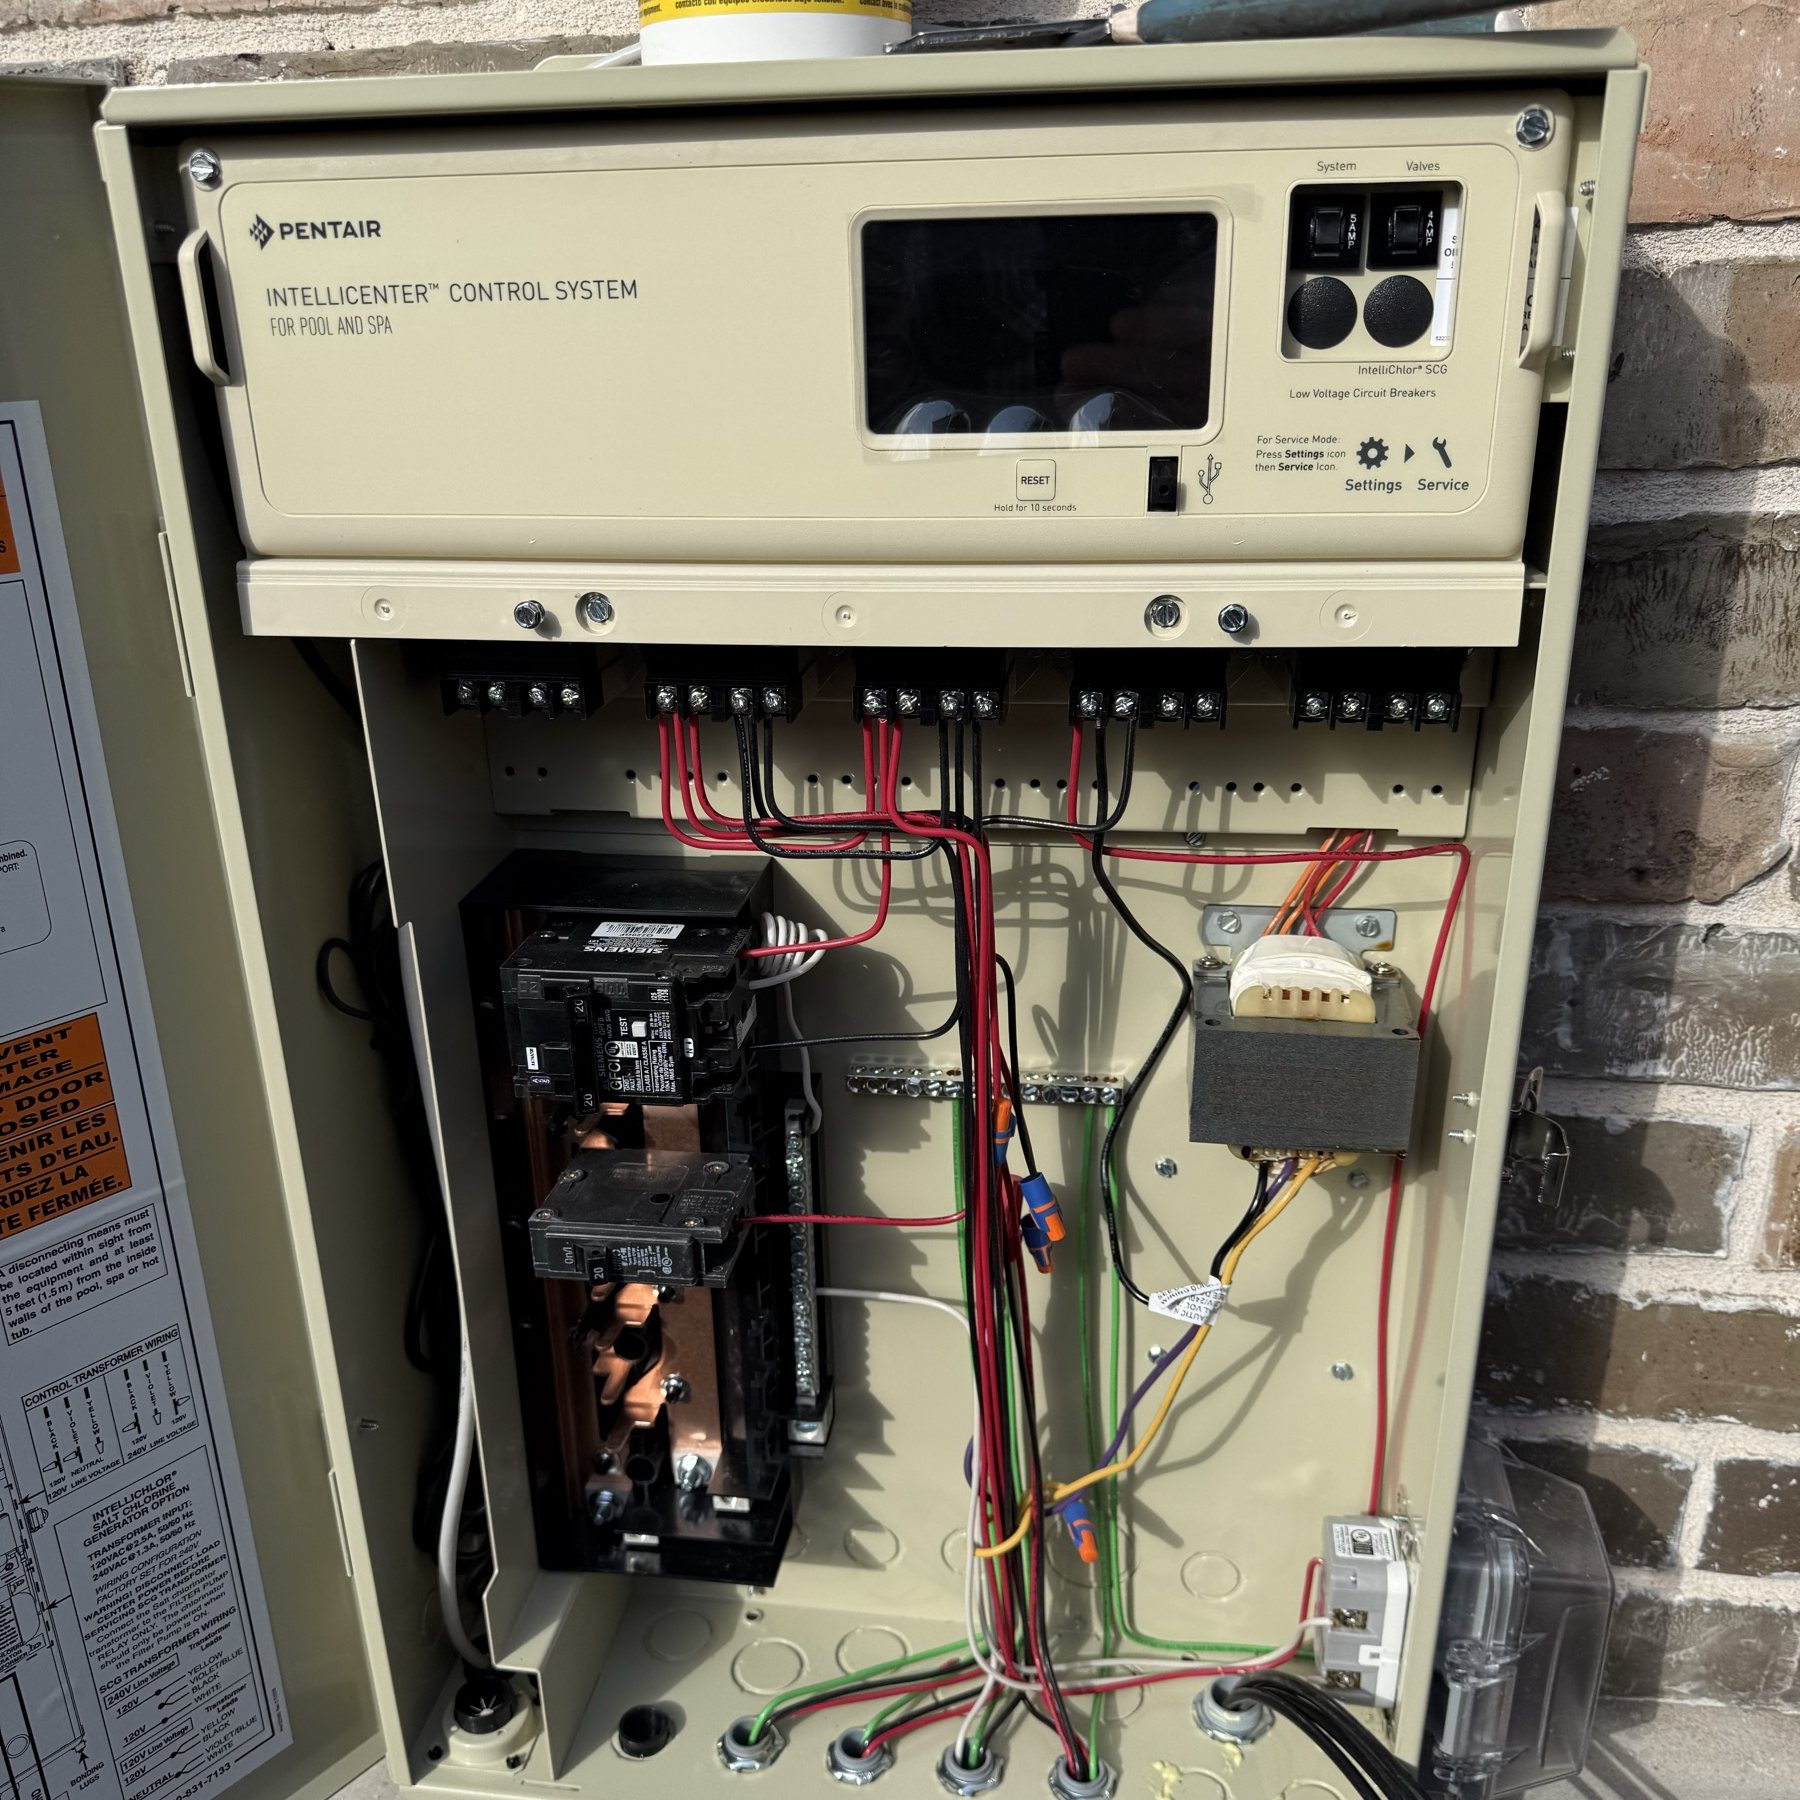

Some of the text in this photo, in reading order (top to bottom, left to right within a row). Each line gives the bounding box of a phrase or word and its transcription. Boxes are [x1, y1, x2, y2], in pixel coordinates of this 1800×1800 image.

[1316, 161, 1356, 173] System
[1406, 161, 1440, 172] Valves
[279, 220, 382, 240] PENTAIR
[1348, 214, 1356, 250] 5 AMP
[1425, 210, 1434, 246] 4 AMP
[449, 281, 550, 303] CONTROL
[555, 279, 638, 301] SYSTEM
[270, 315, 393, 336] FOR POOL AND SPA
[1425, 364, 1448, 375] SCG
[1290, 388, 1436, 400] Low Voltage Circuit Breakers
[1256, 436, 1272, 444] For
[1275, 435, 1309, 444] Service
[1255, 463, 1276, 472] then
[1278, 462, 1314, 471] Service
[1256, 450, 1346, 460] Press Settings icon
[1021, 476, 1050, 485] RESET
[1345, 479, 1470, 493] Settings Service
[994, 504, 1014, 512] Hold
[583, 946, 663, 954] SIEMENS
[575, 999, 584, 1013] 20
[619, 1017, 629, 1036] TEST
[607, 1058, 623, 1090] GFCI
[16, 1072, 105, 1112] DOOR
[584, 1093, 593, 1106] 20
[61, 1112, 106, 1139] LES
[40, 1131, 118, 1169] D'EAU.
[60, 1165, 90, 1186] LA
[28, 1174, 122, 1222] FERMÉE.
[8, 1209, 150, 1274] disconnecting means must
[0, 1222, 152, 1292] be located within sight from
[2, 1233, 154, 1304] the equipment and at least
[5, 1245, 156, 1316] 5 feet from the inside
[593, 1267, 604, 1279] 20
[8, 1256, 160, 1328] walls of the pool, spa or hot
[11, 1327, 32, 1341] tub.
[25, 1328, 178, 1408] CONTROL TRANSFORMER WIRING
[127, 1420, 197, 1460] 240V VOLTAGE
[50, 1458, 105, 1488] 120V NEUTRAL
[71, 1459, 121, 1488] LINE VOLTAGE
[83, 1484, 190, 1547] GENERATOR OPTION
[93, 1482, 176, 1532] SALT CHLORINE
[87, 1500, 192, 1561] TRANSFORMER INPUT:
[158, 1517, 180, 1534] 50/60
[160, 1527, 182, 1544] 50/60
[96, 1529, 202, 1595] WIRING CONFIGURATION
[84, 1540, 221, 1622] WARNING! DISCONNECT LOAD
[97, 1554, 178, 1605] FACTORY SET FOR
[97, 1555, 210, 1624] CENTER POWER BEFORE
[84, 1553, 227, 1641] SERVICING SCG TRANSFORMER
[96, 1570, 216, 1644] Connect the Salt chlorinator
[89, 1570, 228, 1658] transformer the FILTER PUMP
[98, 1583, 225, 1662] RELAY ONLY. The chlorinator
[100, 1592, 226, 1670] should powered when
[156, 1627, 182, 1645] Pump
[188, 1622, 231, 1650] Transformer
[100, 1606, 237, 1694] SCG TRANSFORMER WIRING
[188, 1651, 223, 1677] YELLOW
[108, 1660, 176, 1706] 240V Voltage
[192, 1672, 220, 1694] BLACK
[194, 1682, 222, 1703] WHITE
[116, 1697, 140, 1715] 120V
[205, 1684, 247, 1713] Transformer
[123, 1724, 147, 1743] 120V
[200, 1708, 236, 1734] YELLOW
[203, 1720, 231, 1742] BLACK
[123, 1725, 189, 1769] 120V Voltage
[207, 1740, 234, 1762] WHITE
[70, 1762, 104, 1791] BONDING LUGS
[124, 1766, 147, 1784] 120V
[128, 1772, 175, 1800] NEUTRAL
